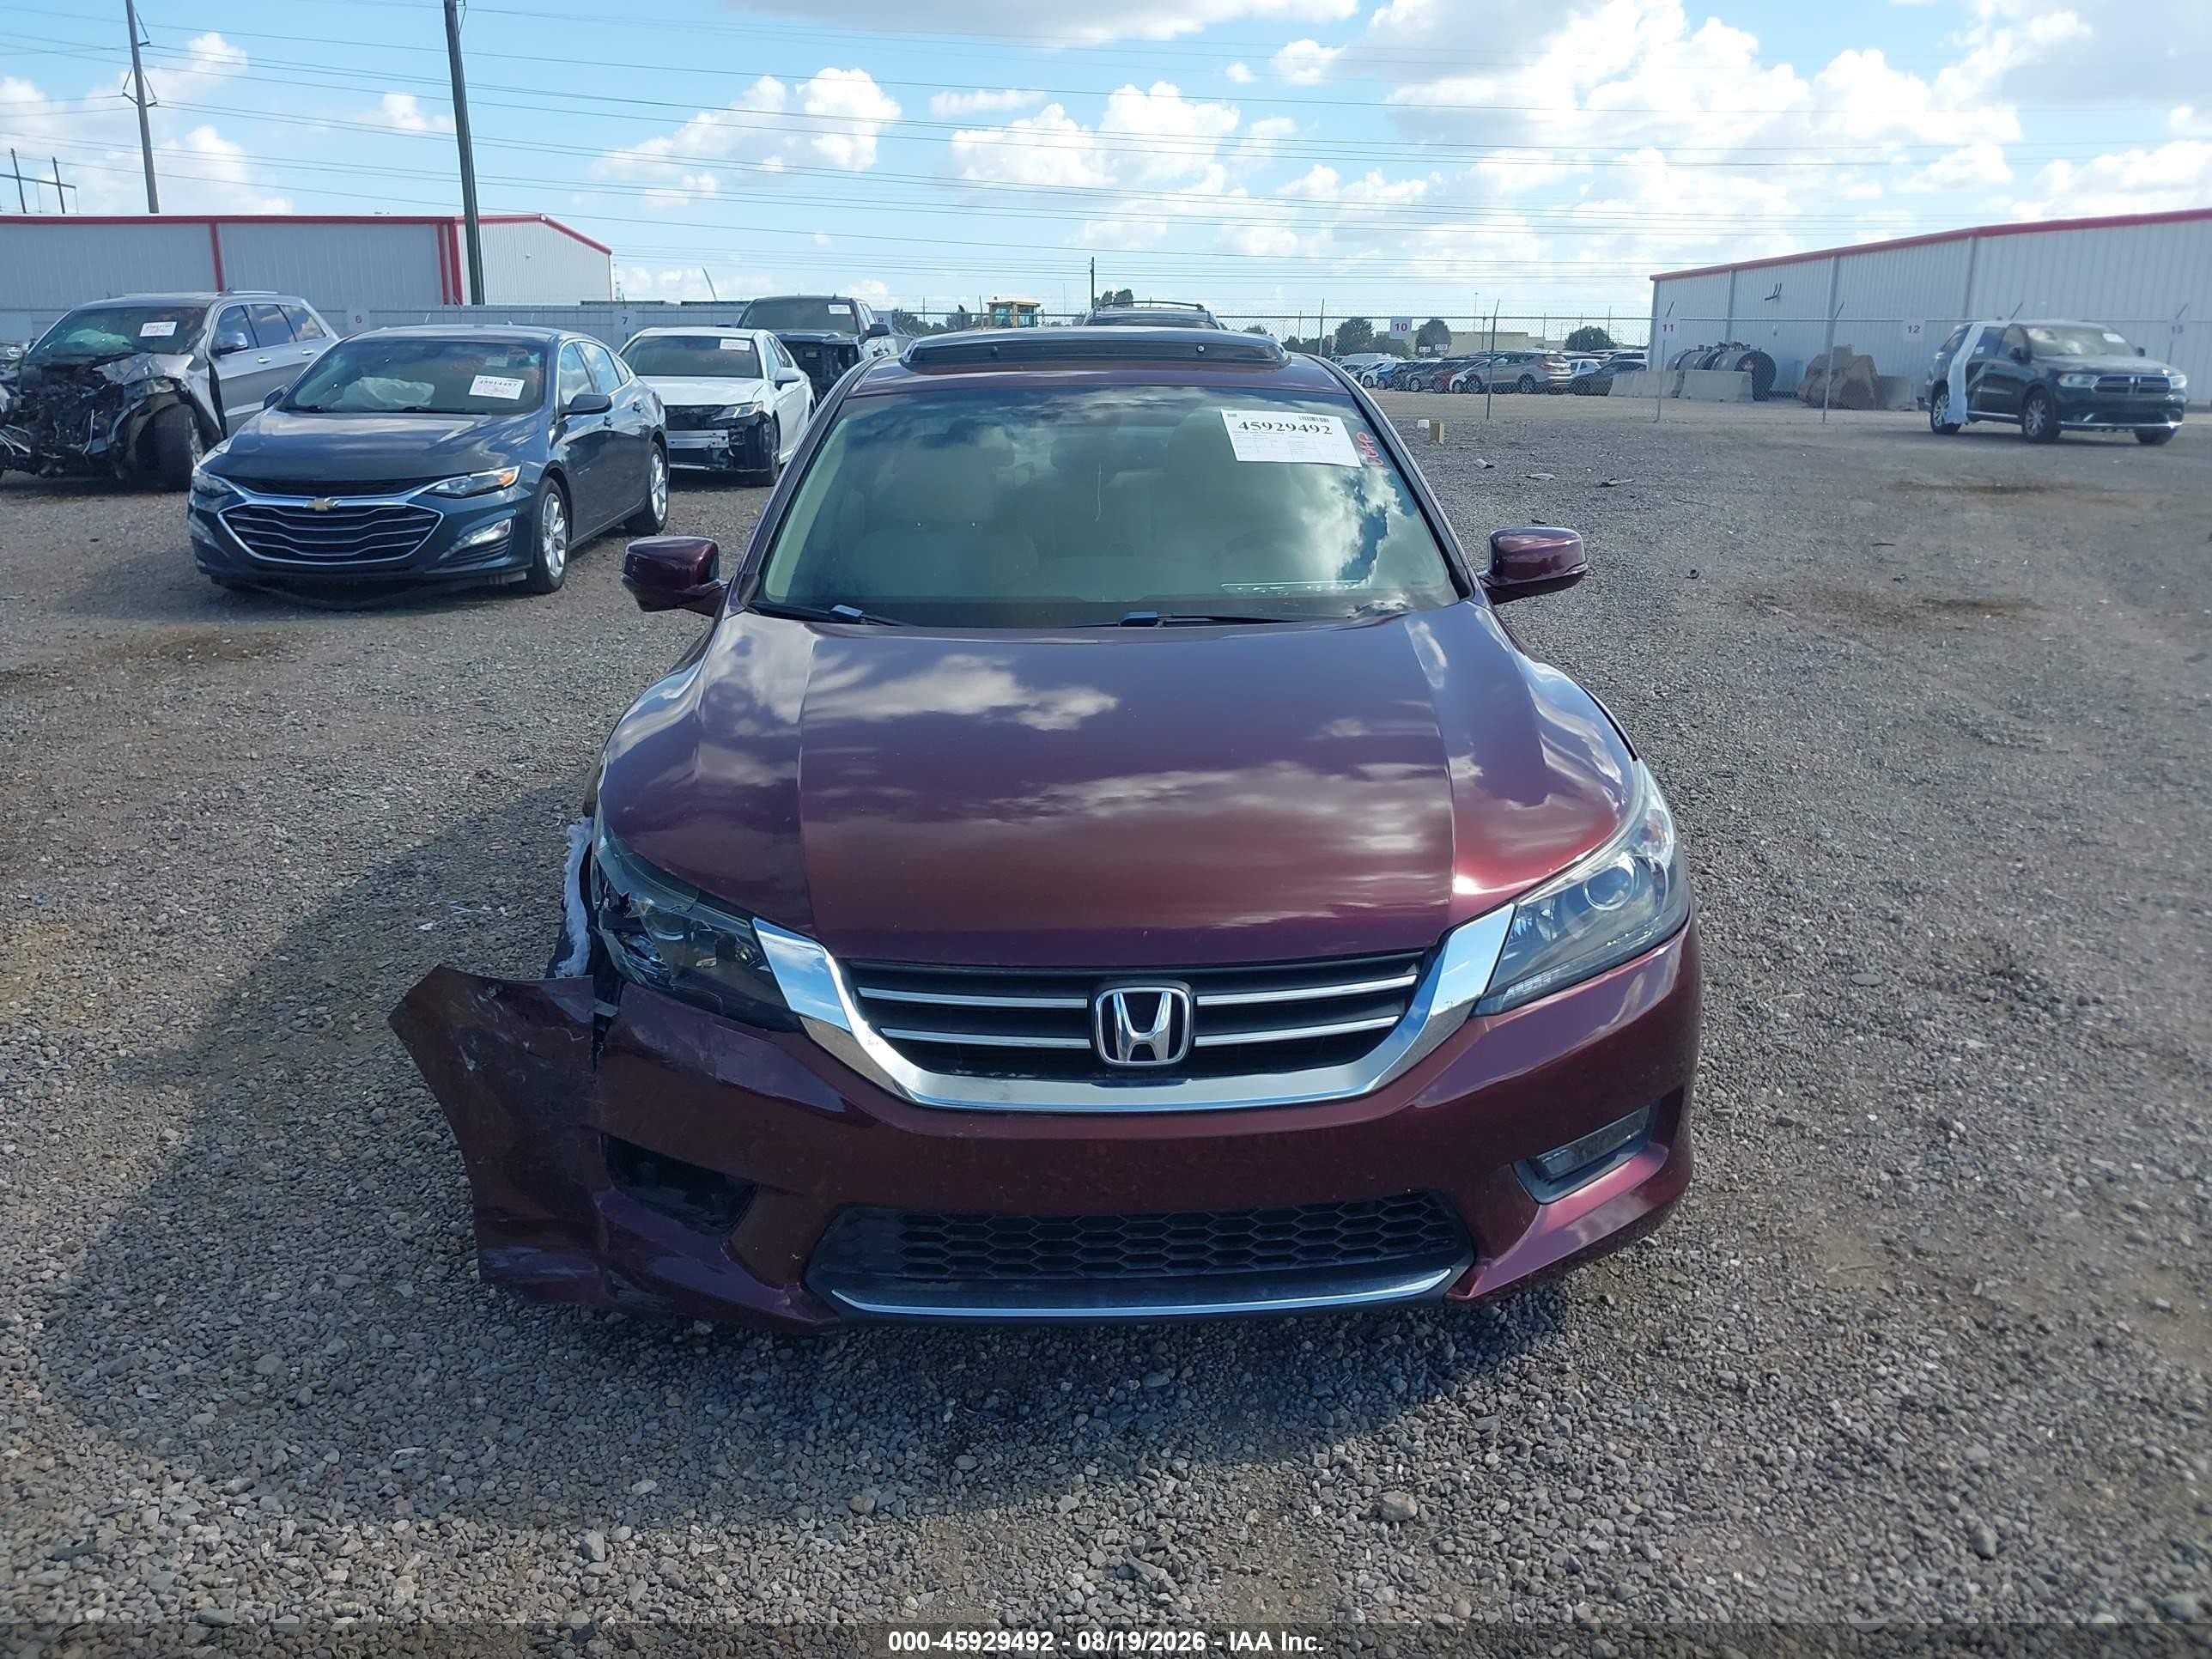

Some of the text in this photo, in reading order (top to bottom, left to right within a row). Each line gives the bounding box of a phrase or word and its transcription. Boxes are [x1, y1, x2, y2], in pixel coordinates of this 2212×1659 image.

[622, 316, 629, 325] 7
[1395, 323, 1408, 331] 10
[1662, 324, 1674, 332] 11
[1908, 325, 1920, 334] 12
[2172, 325, 2184, 334] 13
[1238, 421, 1333, 434] 45929492
